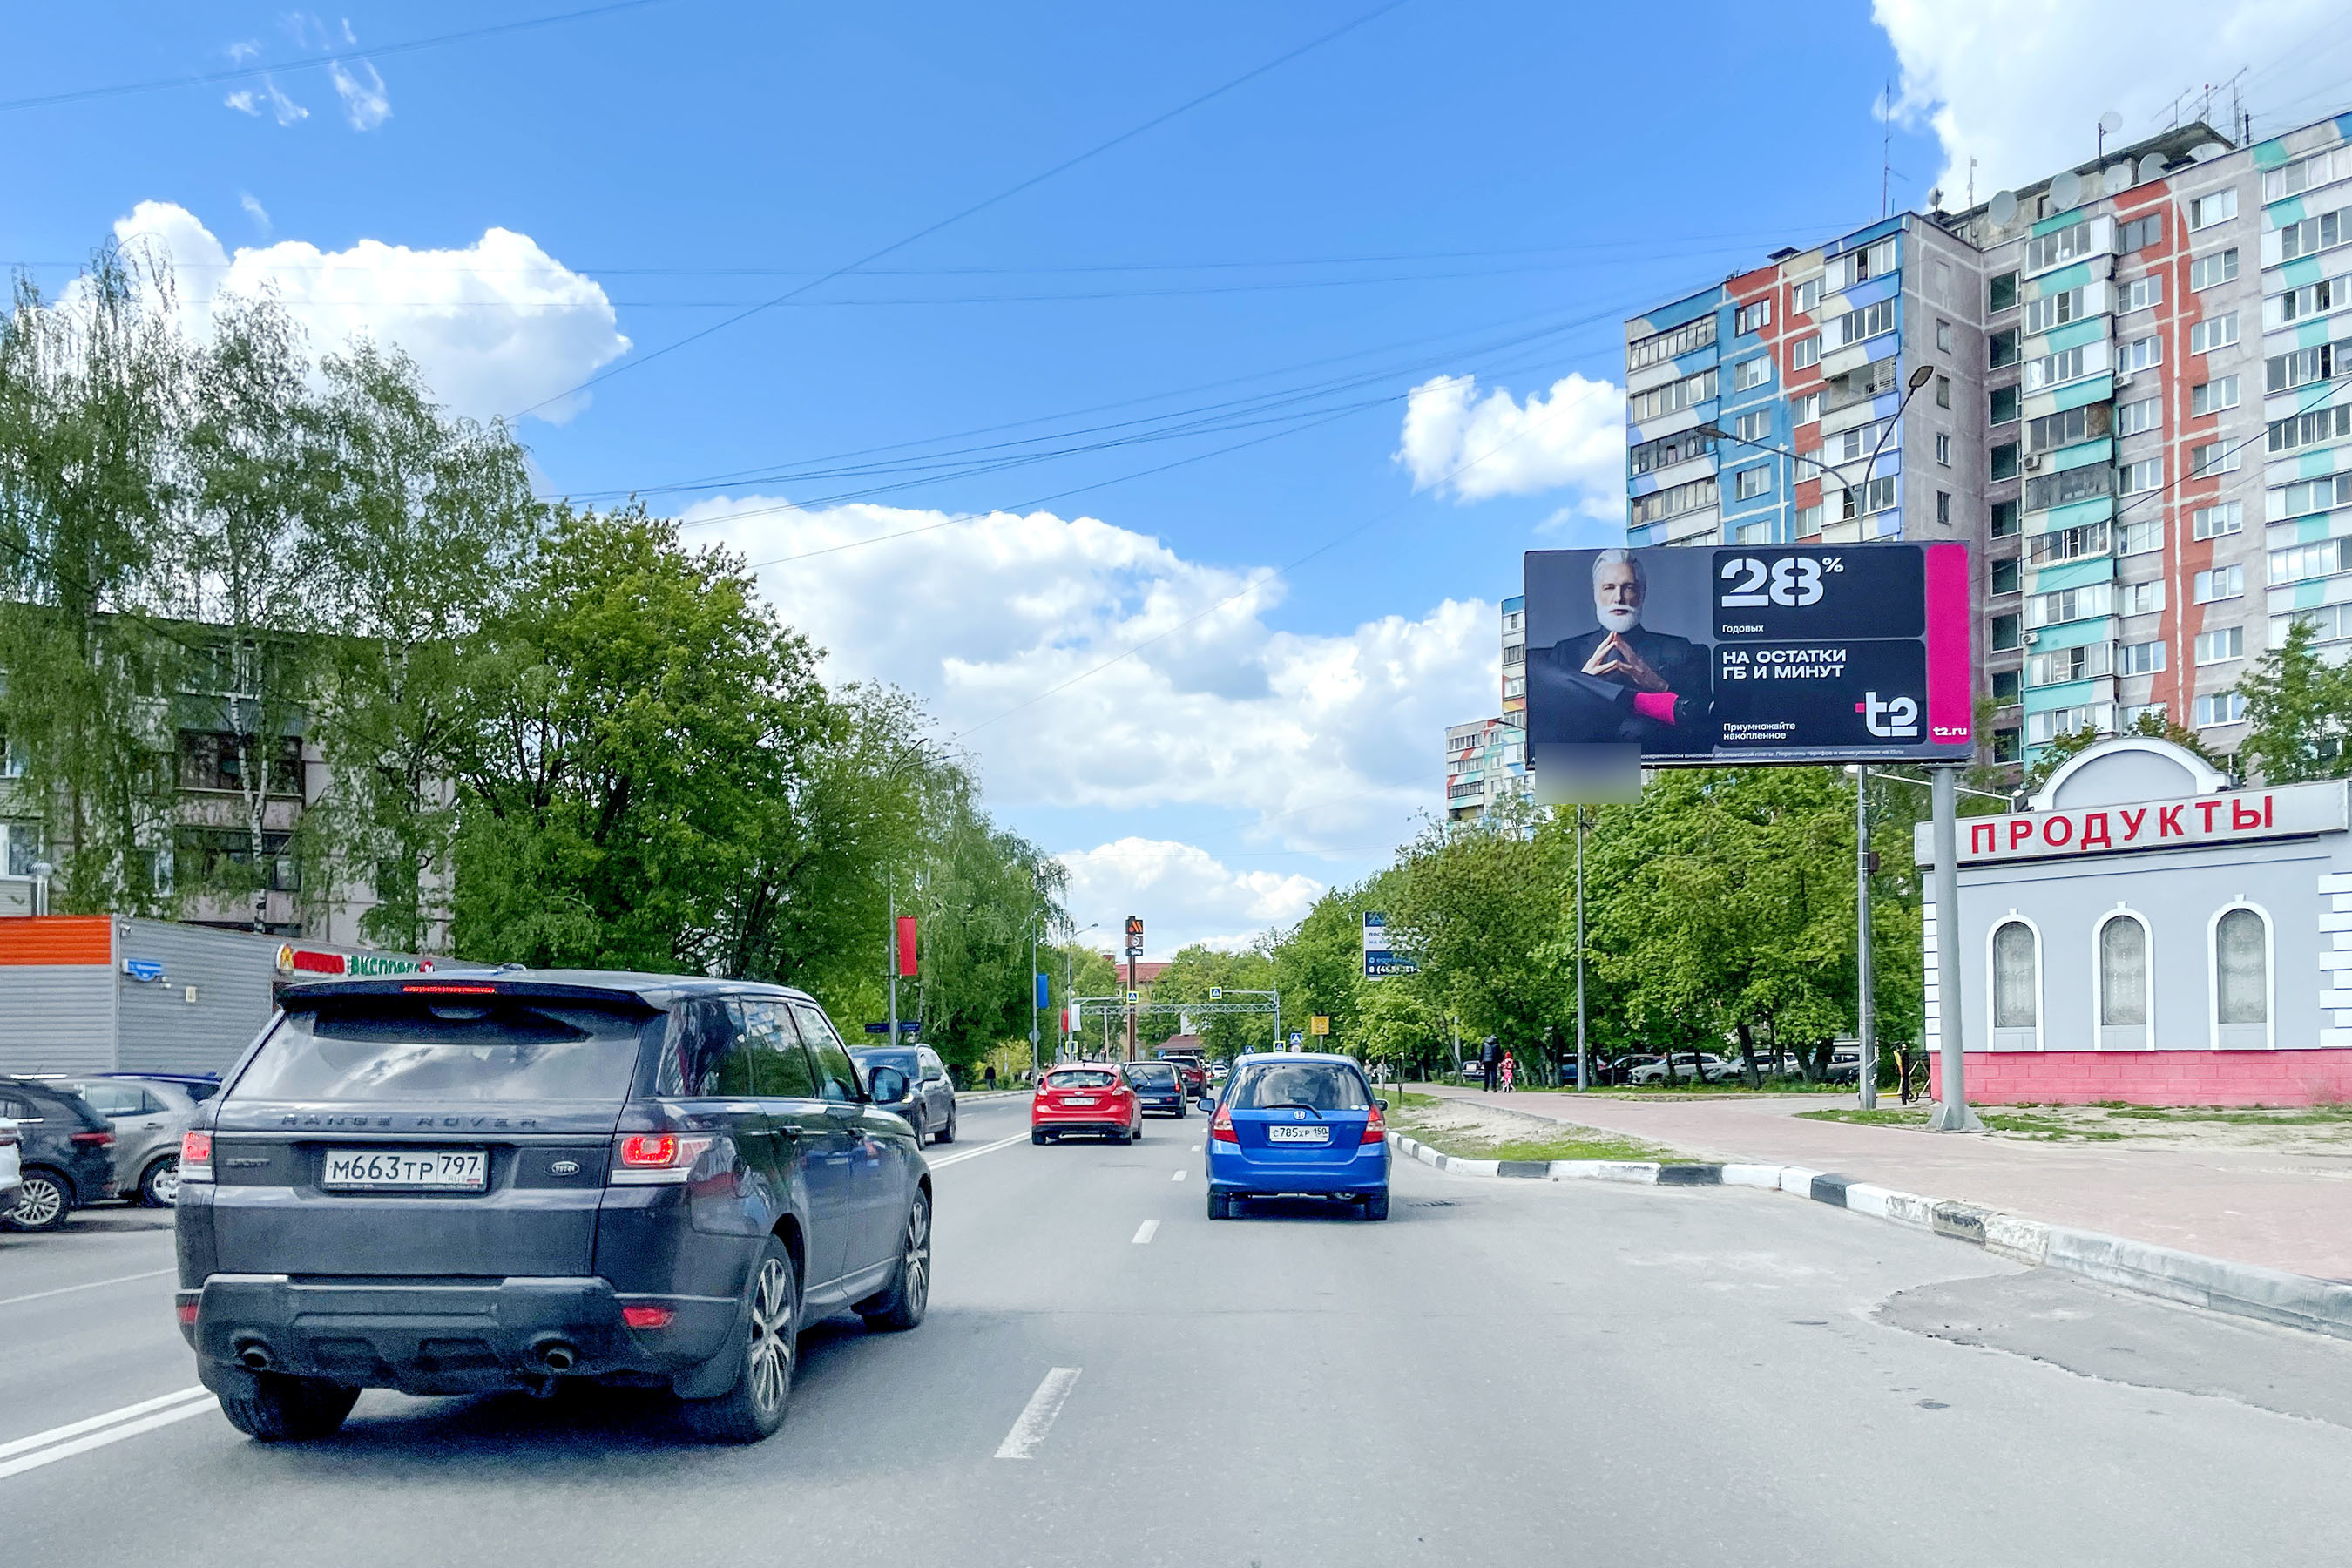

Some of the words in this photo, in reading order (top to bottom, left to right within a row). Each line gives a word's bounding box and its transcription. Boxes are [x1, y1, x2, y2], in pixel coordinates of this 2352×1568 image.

[1721, 557, 1844, 607] 28%
[1722, 624, 1764, 635] Годовых
[1722, 651, 1750, 665] НА
[1755, 649, 1847, 664] ОСТАТКИ
[1722, 666, 1747, 679] ГБ
[1753, 666, 1767, 679] И
[1774, 665, 1845, 679] МИНУТ
[1855, 692, 1918, 737] t2
[1723, 721, 1796, 733] Приумножайте
[1933, 726, 1968, 736] t2.ru
[1723, 732, 1787, 740] накопленное
[1971, 795, 2273, 854] ПРОДУКТЫ
[281, 1115, 392, 1127] RANGE
[416, 1117, 537, 1127] ROVER
[331, 1155, 434, 1181] М663ТР
[440, 1155, 479, 1176] 797
